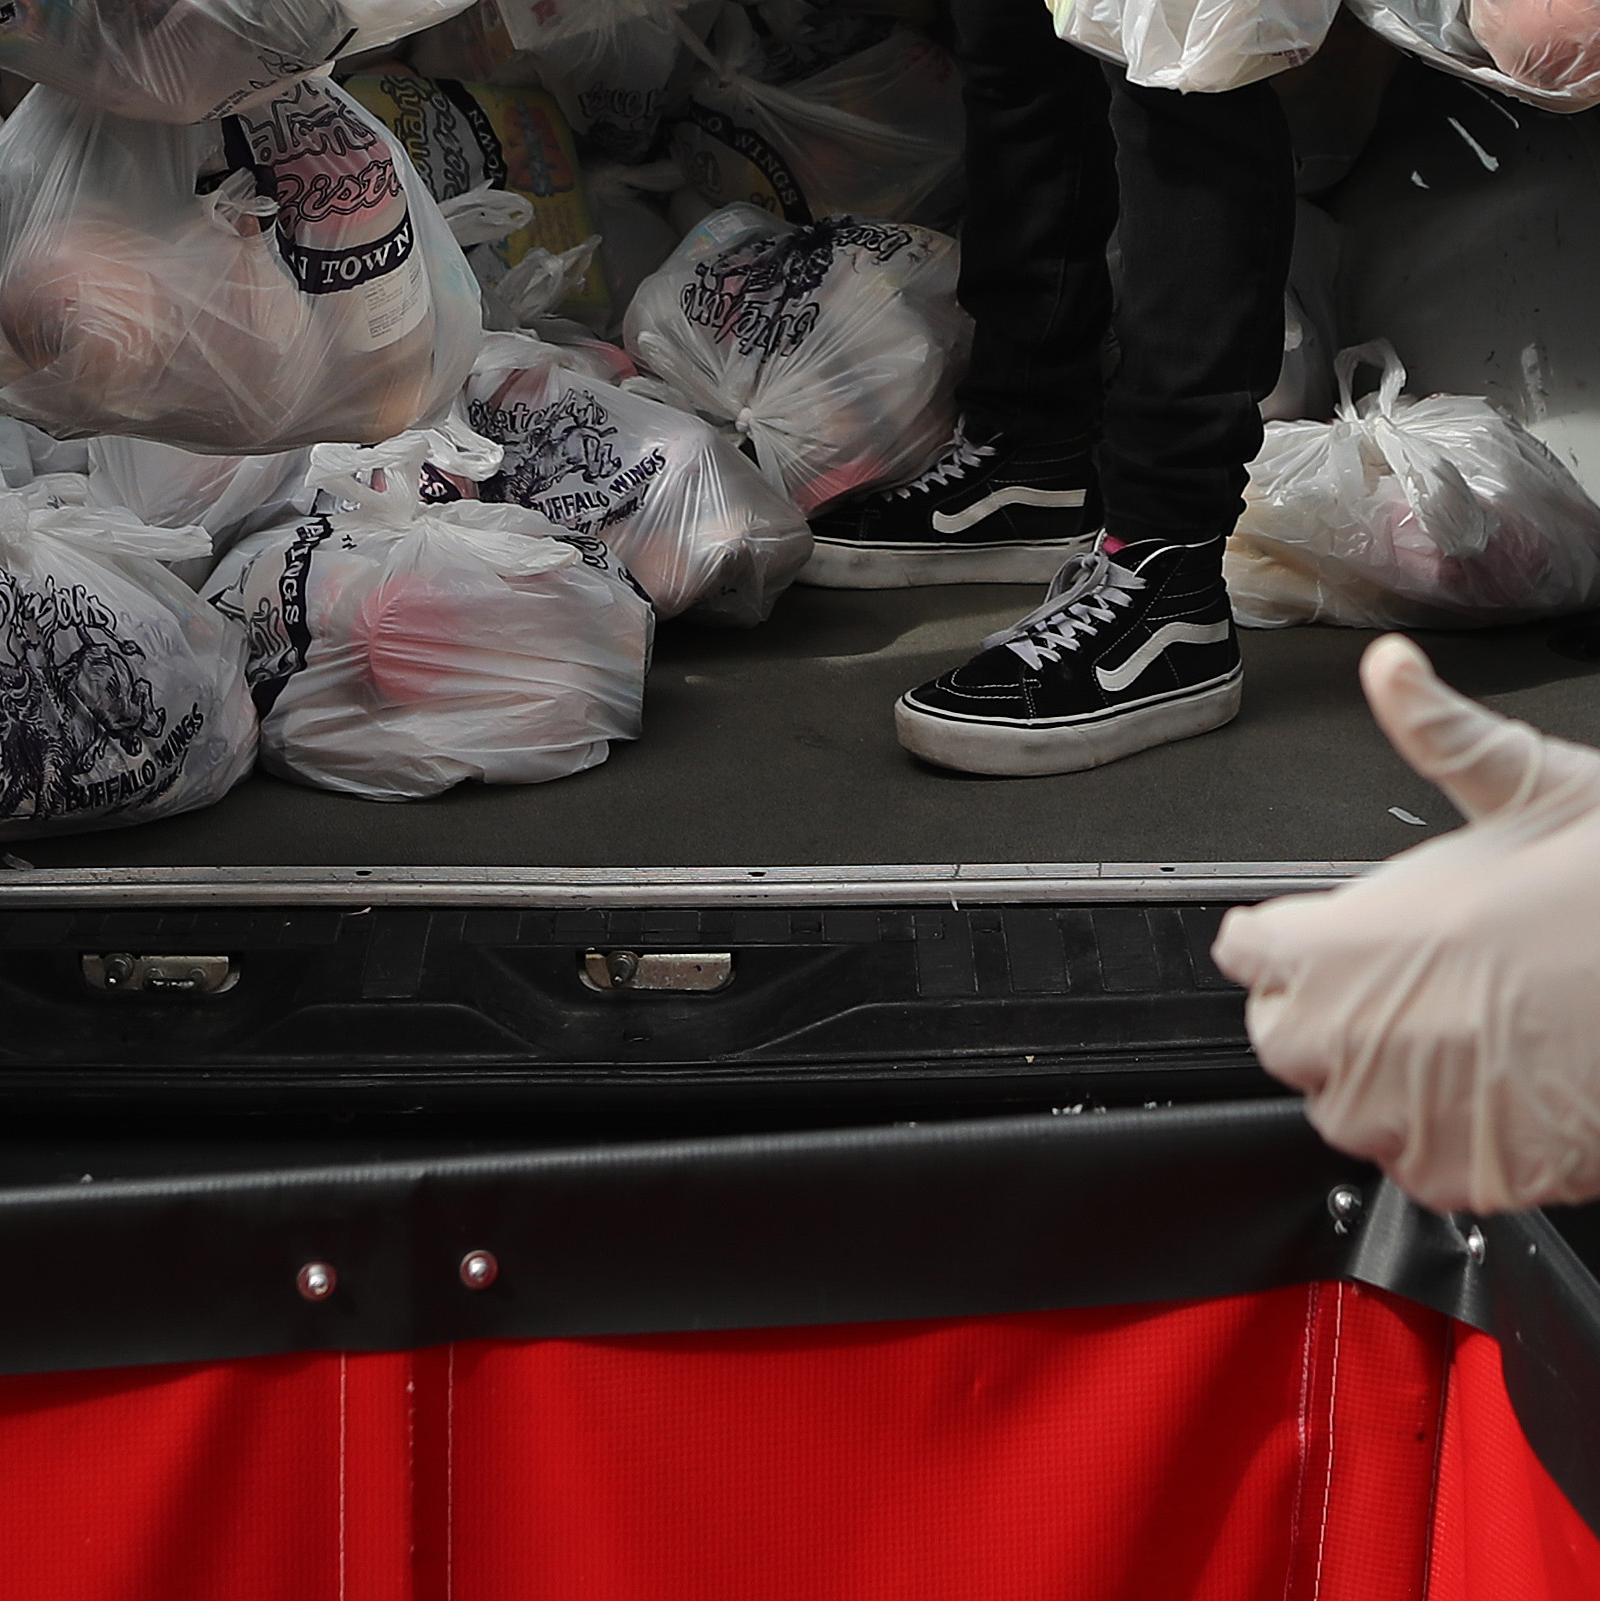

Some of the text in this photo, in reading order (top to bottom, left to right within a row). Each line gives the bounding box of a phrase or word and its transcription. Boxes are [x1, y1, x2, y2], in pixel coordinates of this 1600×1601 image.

[320, 221, 412, 285] TOWN
[609, 448, 667, 498] WINGS
[154, 702, 204, 768] WINGS
